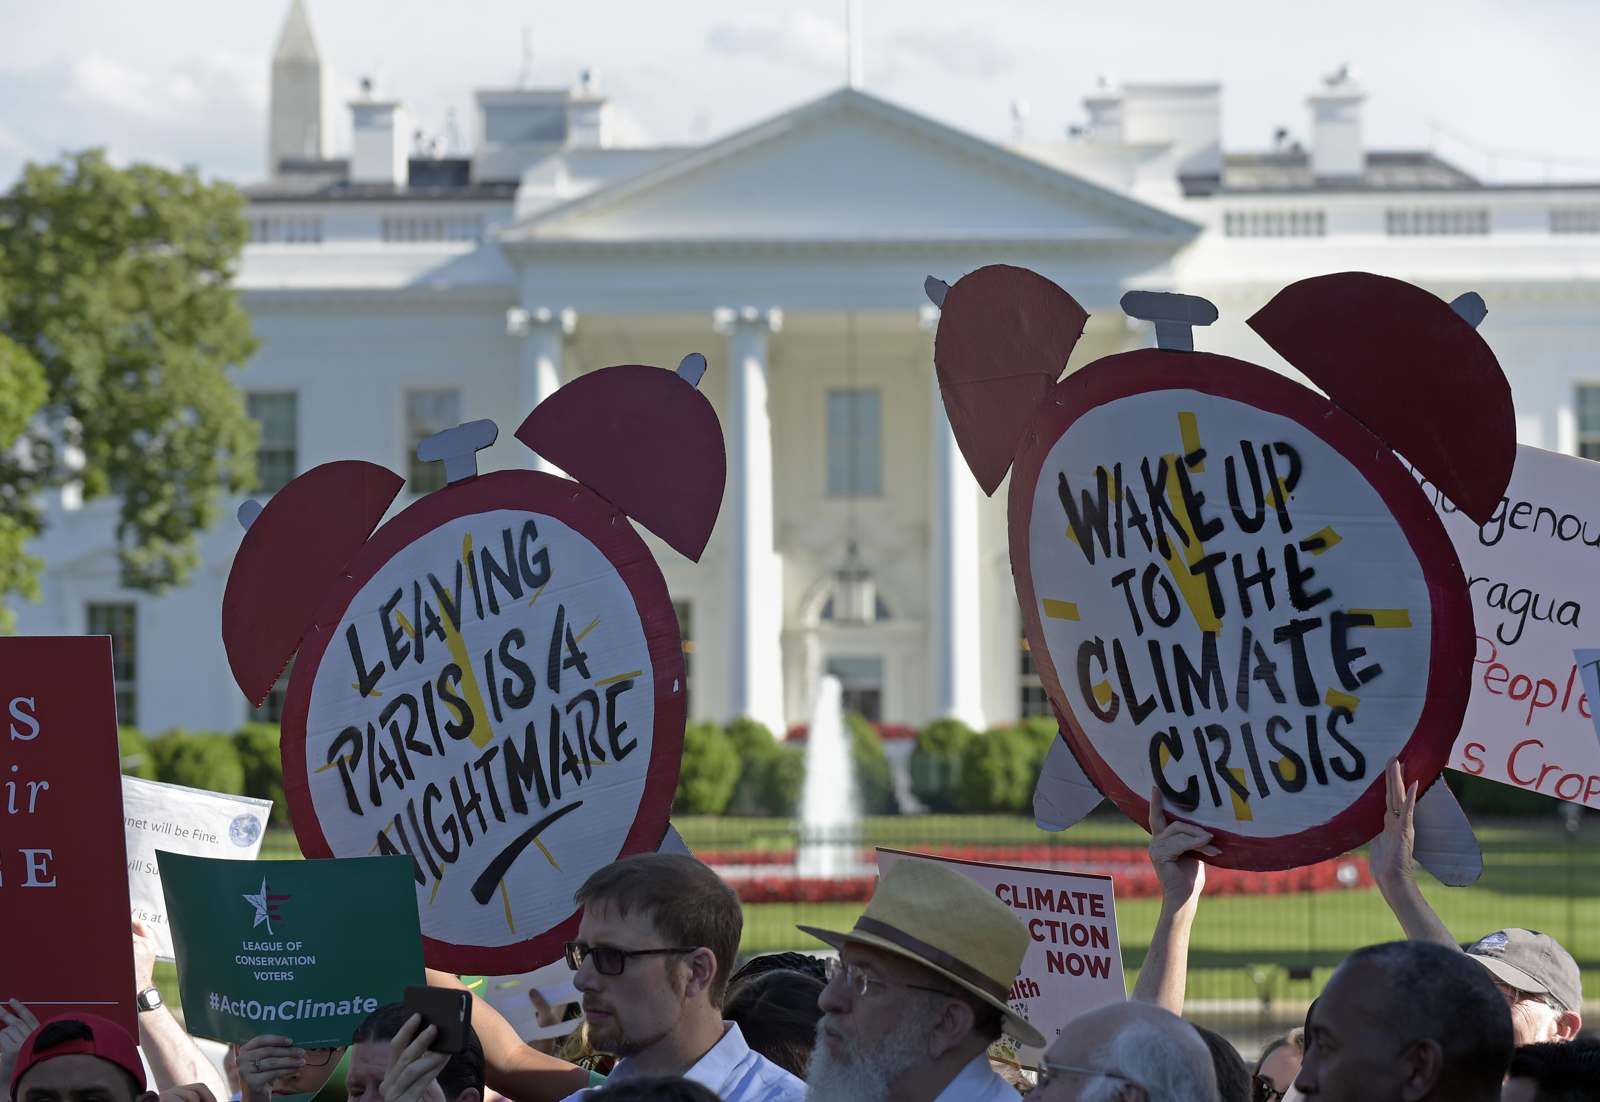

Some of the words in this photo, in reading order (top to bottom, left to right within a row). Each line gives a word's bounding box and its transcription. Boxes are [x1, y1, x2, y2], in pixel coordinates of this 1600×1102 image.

[1058, 449, 1224, 565] WAKE
[1225, 440, 1301, 534] UP
[1112, 563, 1181, 636] TO
[1190, 538, 1333, 618] THE
[346, 520, 552, 697] LEAVING
[1077, 610, 1382, 725] CLIMATE
[328, 663, 474, 815] PARIS
[484, 628, 535, 722] IS
[547, 604, 591, 693] A
[1149, 706, 1366, 811] CRISIS
[378, 680, 637, 886] NIGHTMARE
[151, 822, 172, 834] will
[174, 825, 189, 838] be
[192, 828, 220, 844] Fine.
[138, 910, 148, 921] is
[151, 913, 162, 923] at
[995, 883, 1106, 918] CLIMATE
[235, 955, 316, 966] CONSERVATION
[243, 941, 283, 951] LEAGUE
[286, 941, 302, 951] OF
[253, 971, 294, 981] VOTERS
[1046, 950, 1111, 979] NOW
[209, 992, 378, 1021] #ActOnClimate
